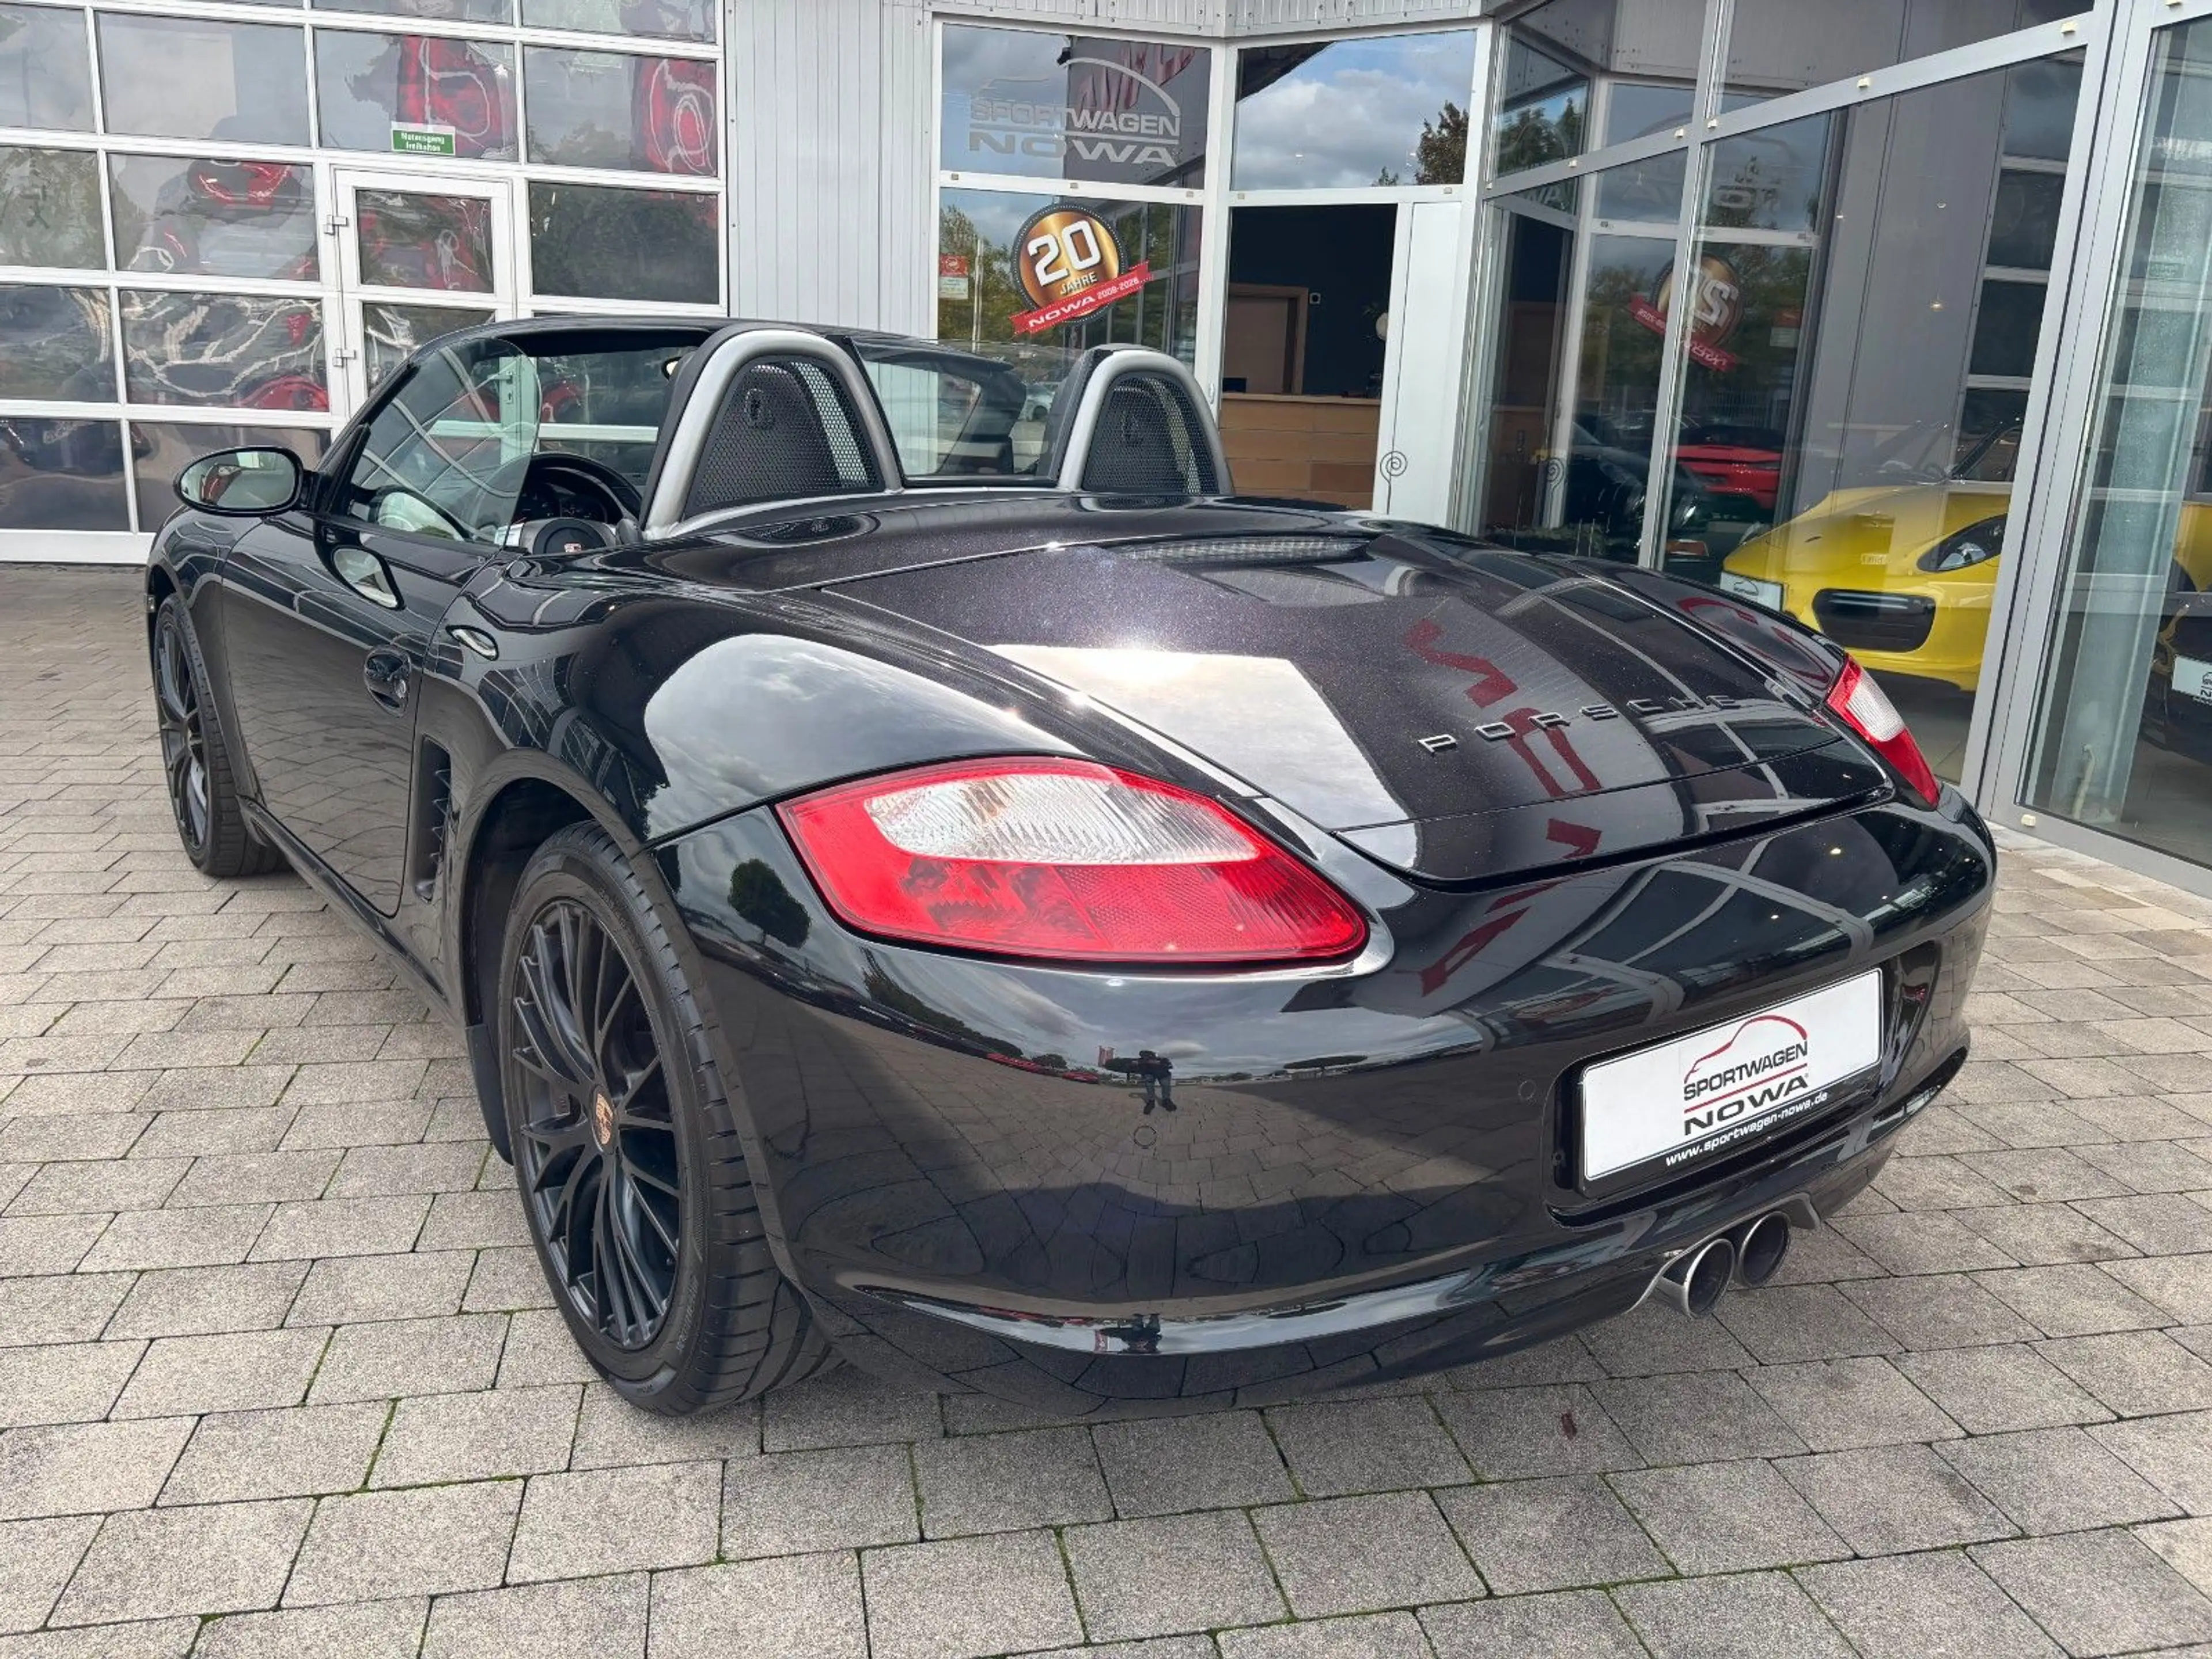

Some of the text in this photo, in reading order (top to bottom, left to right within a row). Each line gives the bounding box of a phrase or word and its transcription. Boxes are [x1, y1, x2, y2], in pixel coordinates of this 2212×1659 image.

[971, 99, 1180, 136] SPORTWAGEN
[969, 131, 1177, 167] NOWA
[1028, 220, 1101, 286] 20
[1060, 272, 1097, 295] JAHRE
[1028, 296, 1096, 327] NOWA
[1417, 694, 1740, 756] PORSCHE
[1684, 1040, 1808, 1101] SPORTWAGEN
[1665, 1092, 1827, 1166] www.sportwagen-nowa.de
[1684, 1075, 1809, 1136] NOWA
